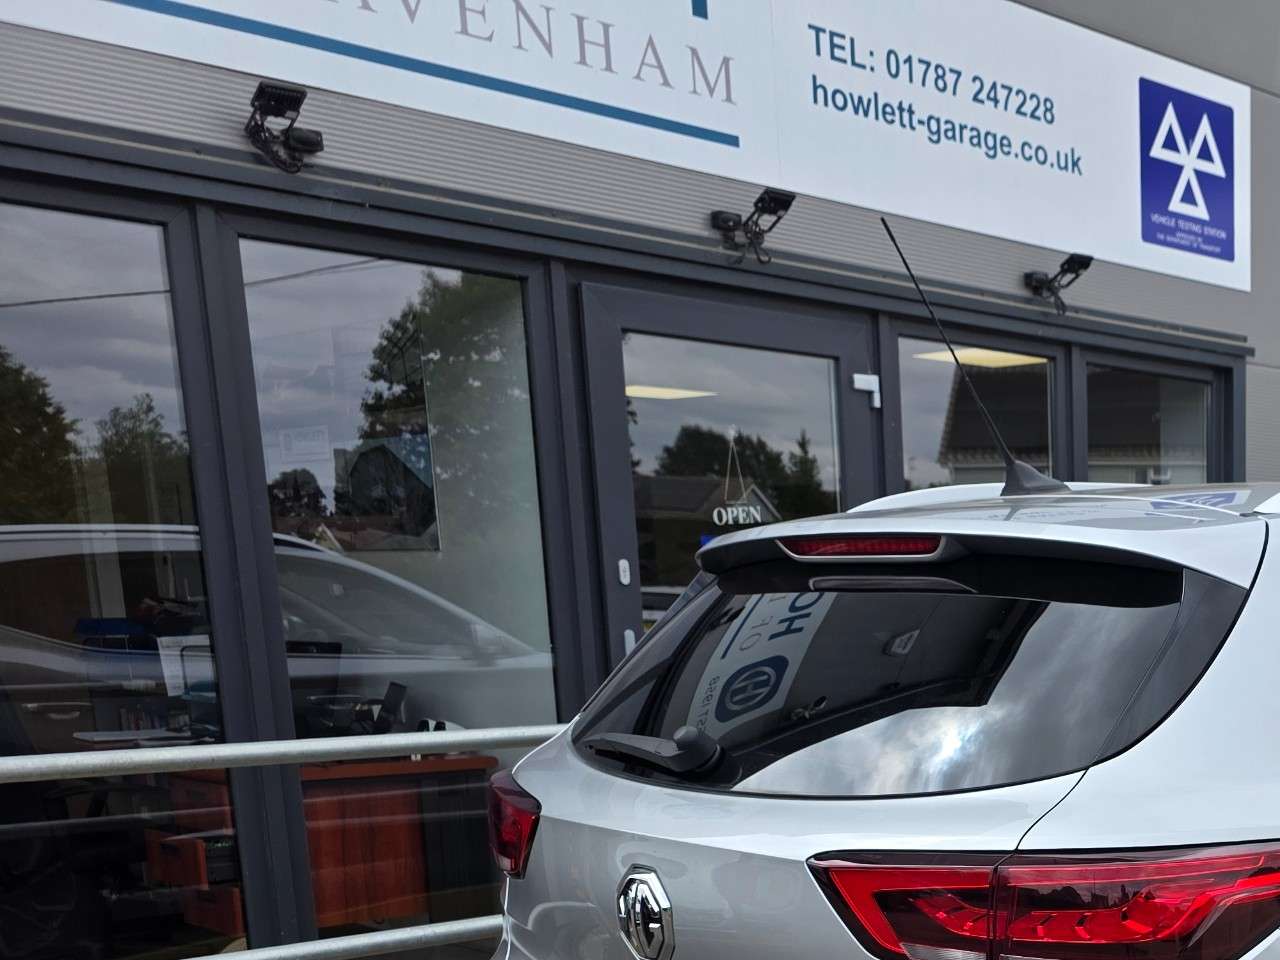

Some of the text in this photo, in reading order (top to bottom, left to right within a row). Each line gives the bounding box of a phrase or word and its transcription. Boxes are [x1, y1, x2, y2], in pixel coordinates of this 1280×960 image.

[328, 0, 738, 106] ENHAM
[808, 24, 1056, 125] TEL: 01787 247228
[812, 74, 1083, 176] howlett-garage.co.uk
[712, 505, 762, 526] OPEN
